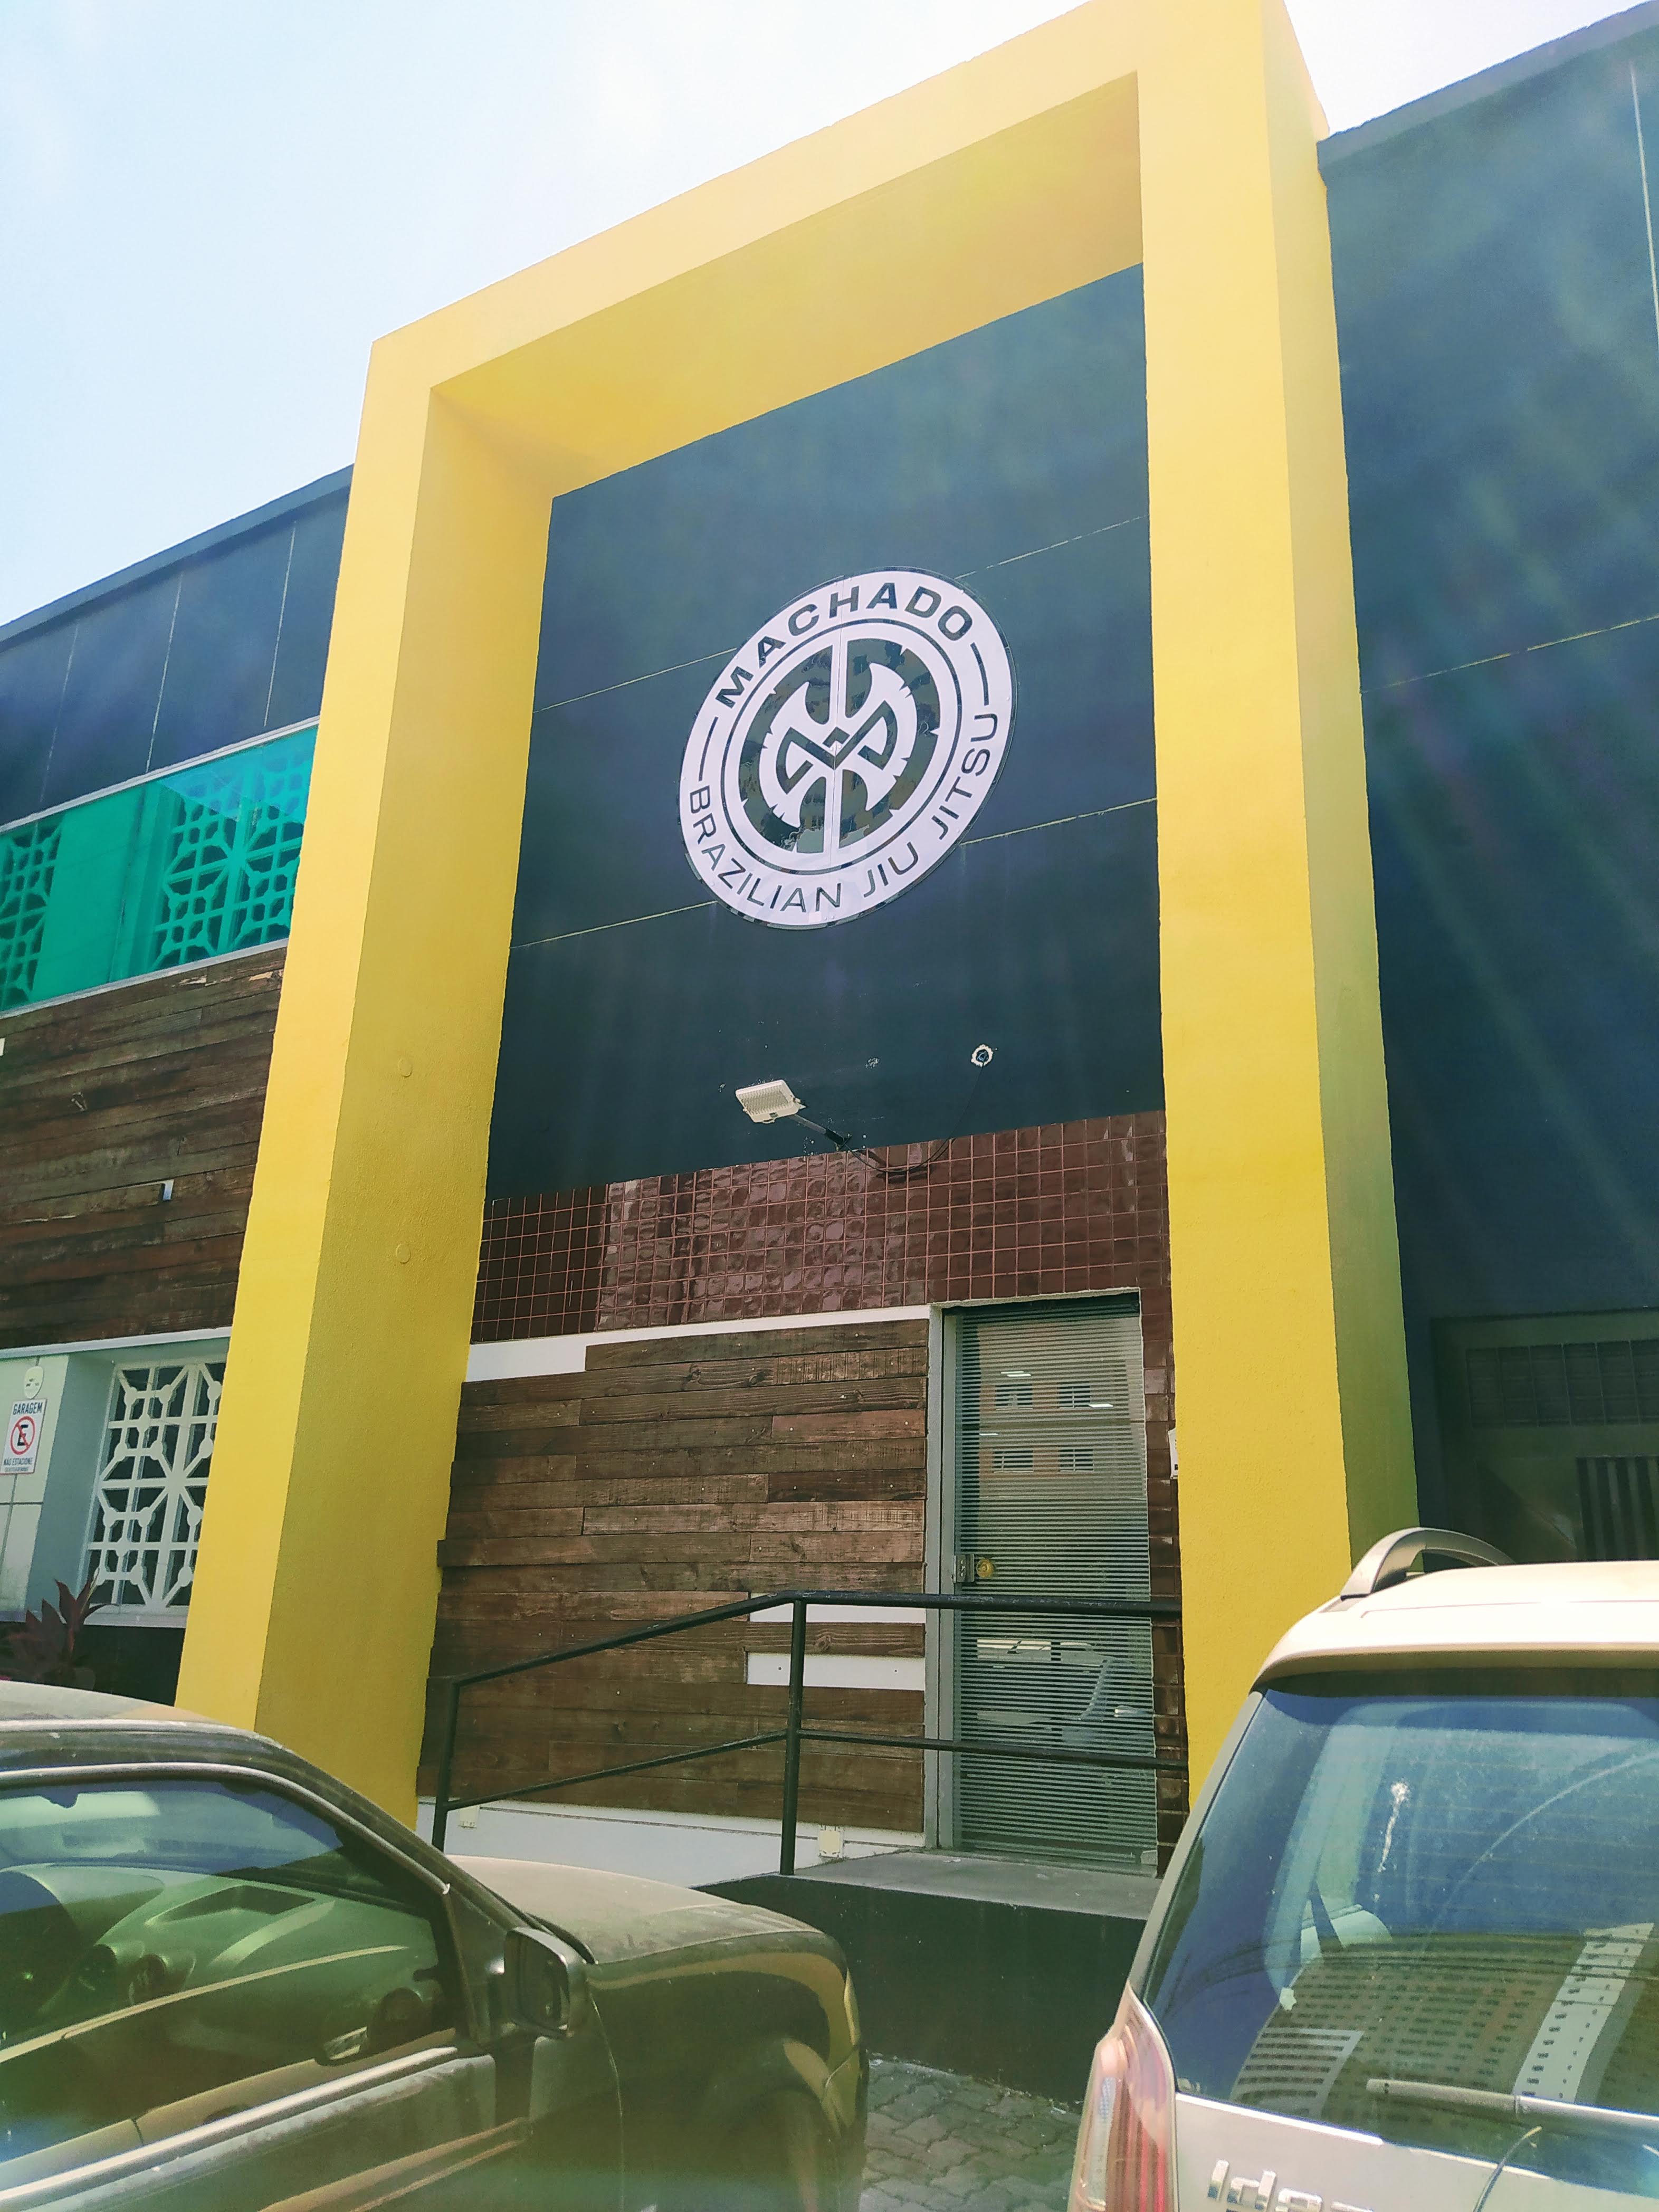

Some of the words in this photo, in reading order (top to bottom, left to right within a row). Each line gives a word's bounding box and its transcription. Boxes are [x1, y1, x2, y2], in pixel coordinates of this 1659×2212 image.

[716, 583, 972, 709] MACHADO
[690, 785, 842, 913] BRAZILIAN
[863, 841, 919, 898] JIU
[930, 712, 998, 841] JITSU
[13, 1402, 43, 1415] GARAGEM
